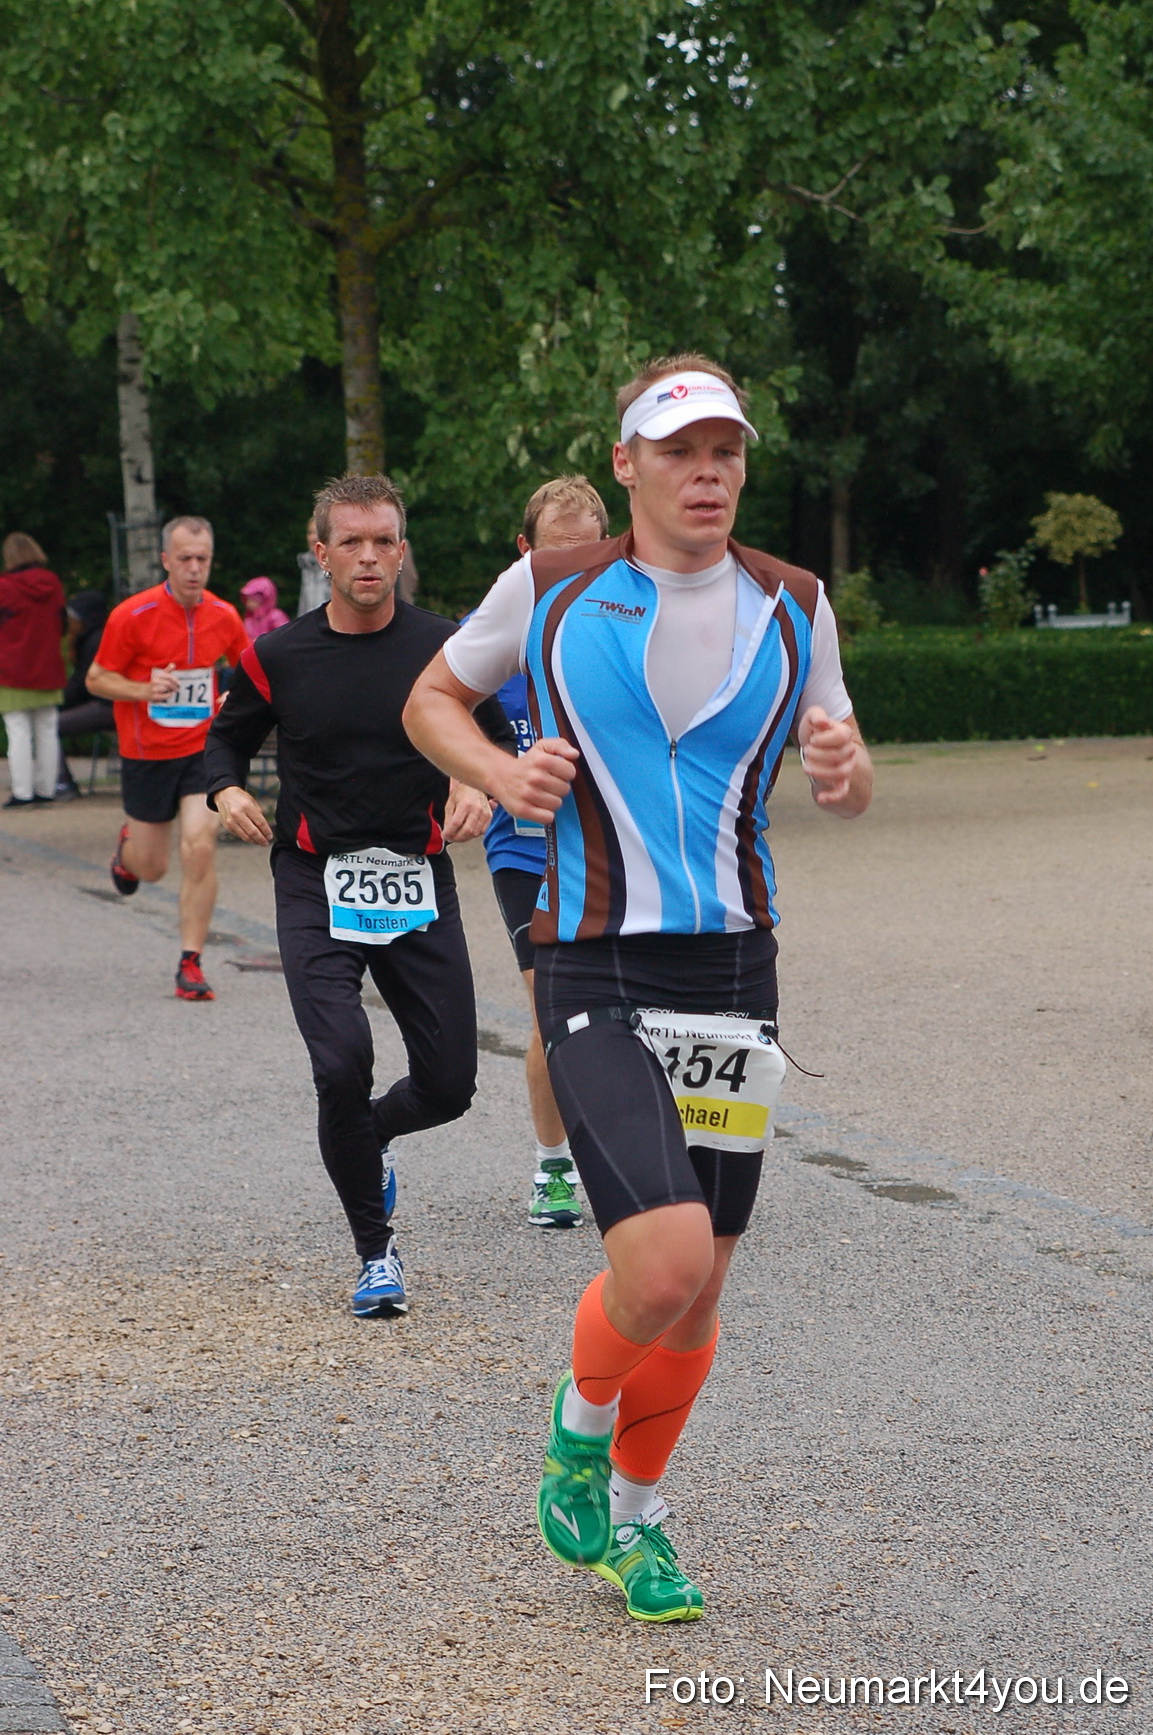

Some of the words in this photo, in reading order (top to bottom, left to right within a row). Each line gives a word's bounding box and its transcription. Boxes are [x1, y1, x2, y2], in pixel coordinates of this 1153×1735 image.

[366, 857, 414, 867] Neumark
[335, 869, 424, 906] 2565
[356, 914, 408, 930] Torsten
